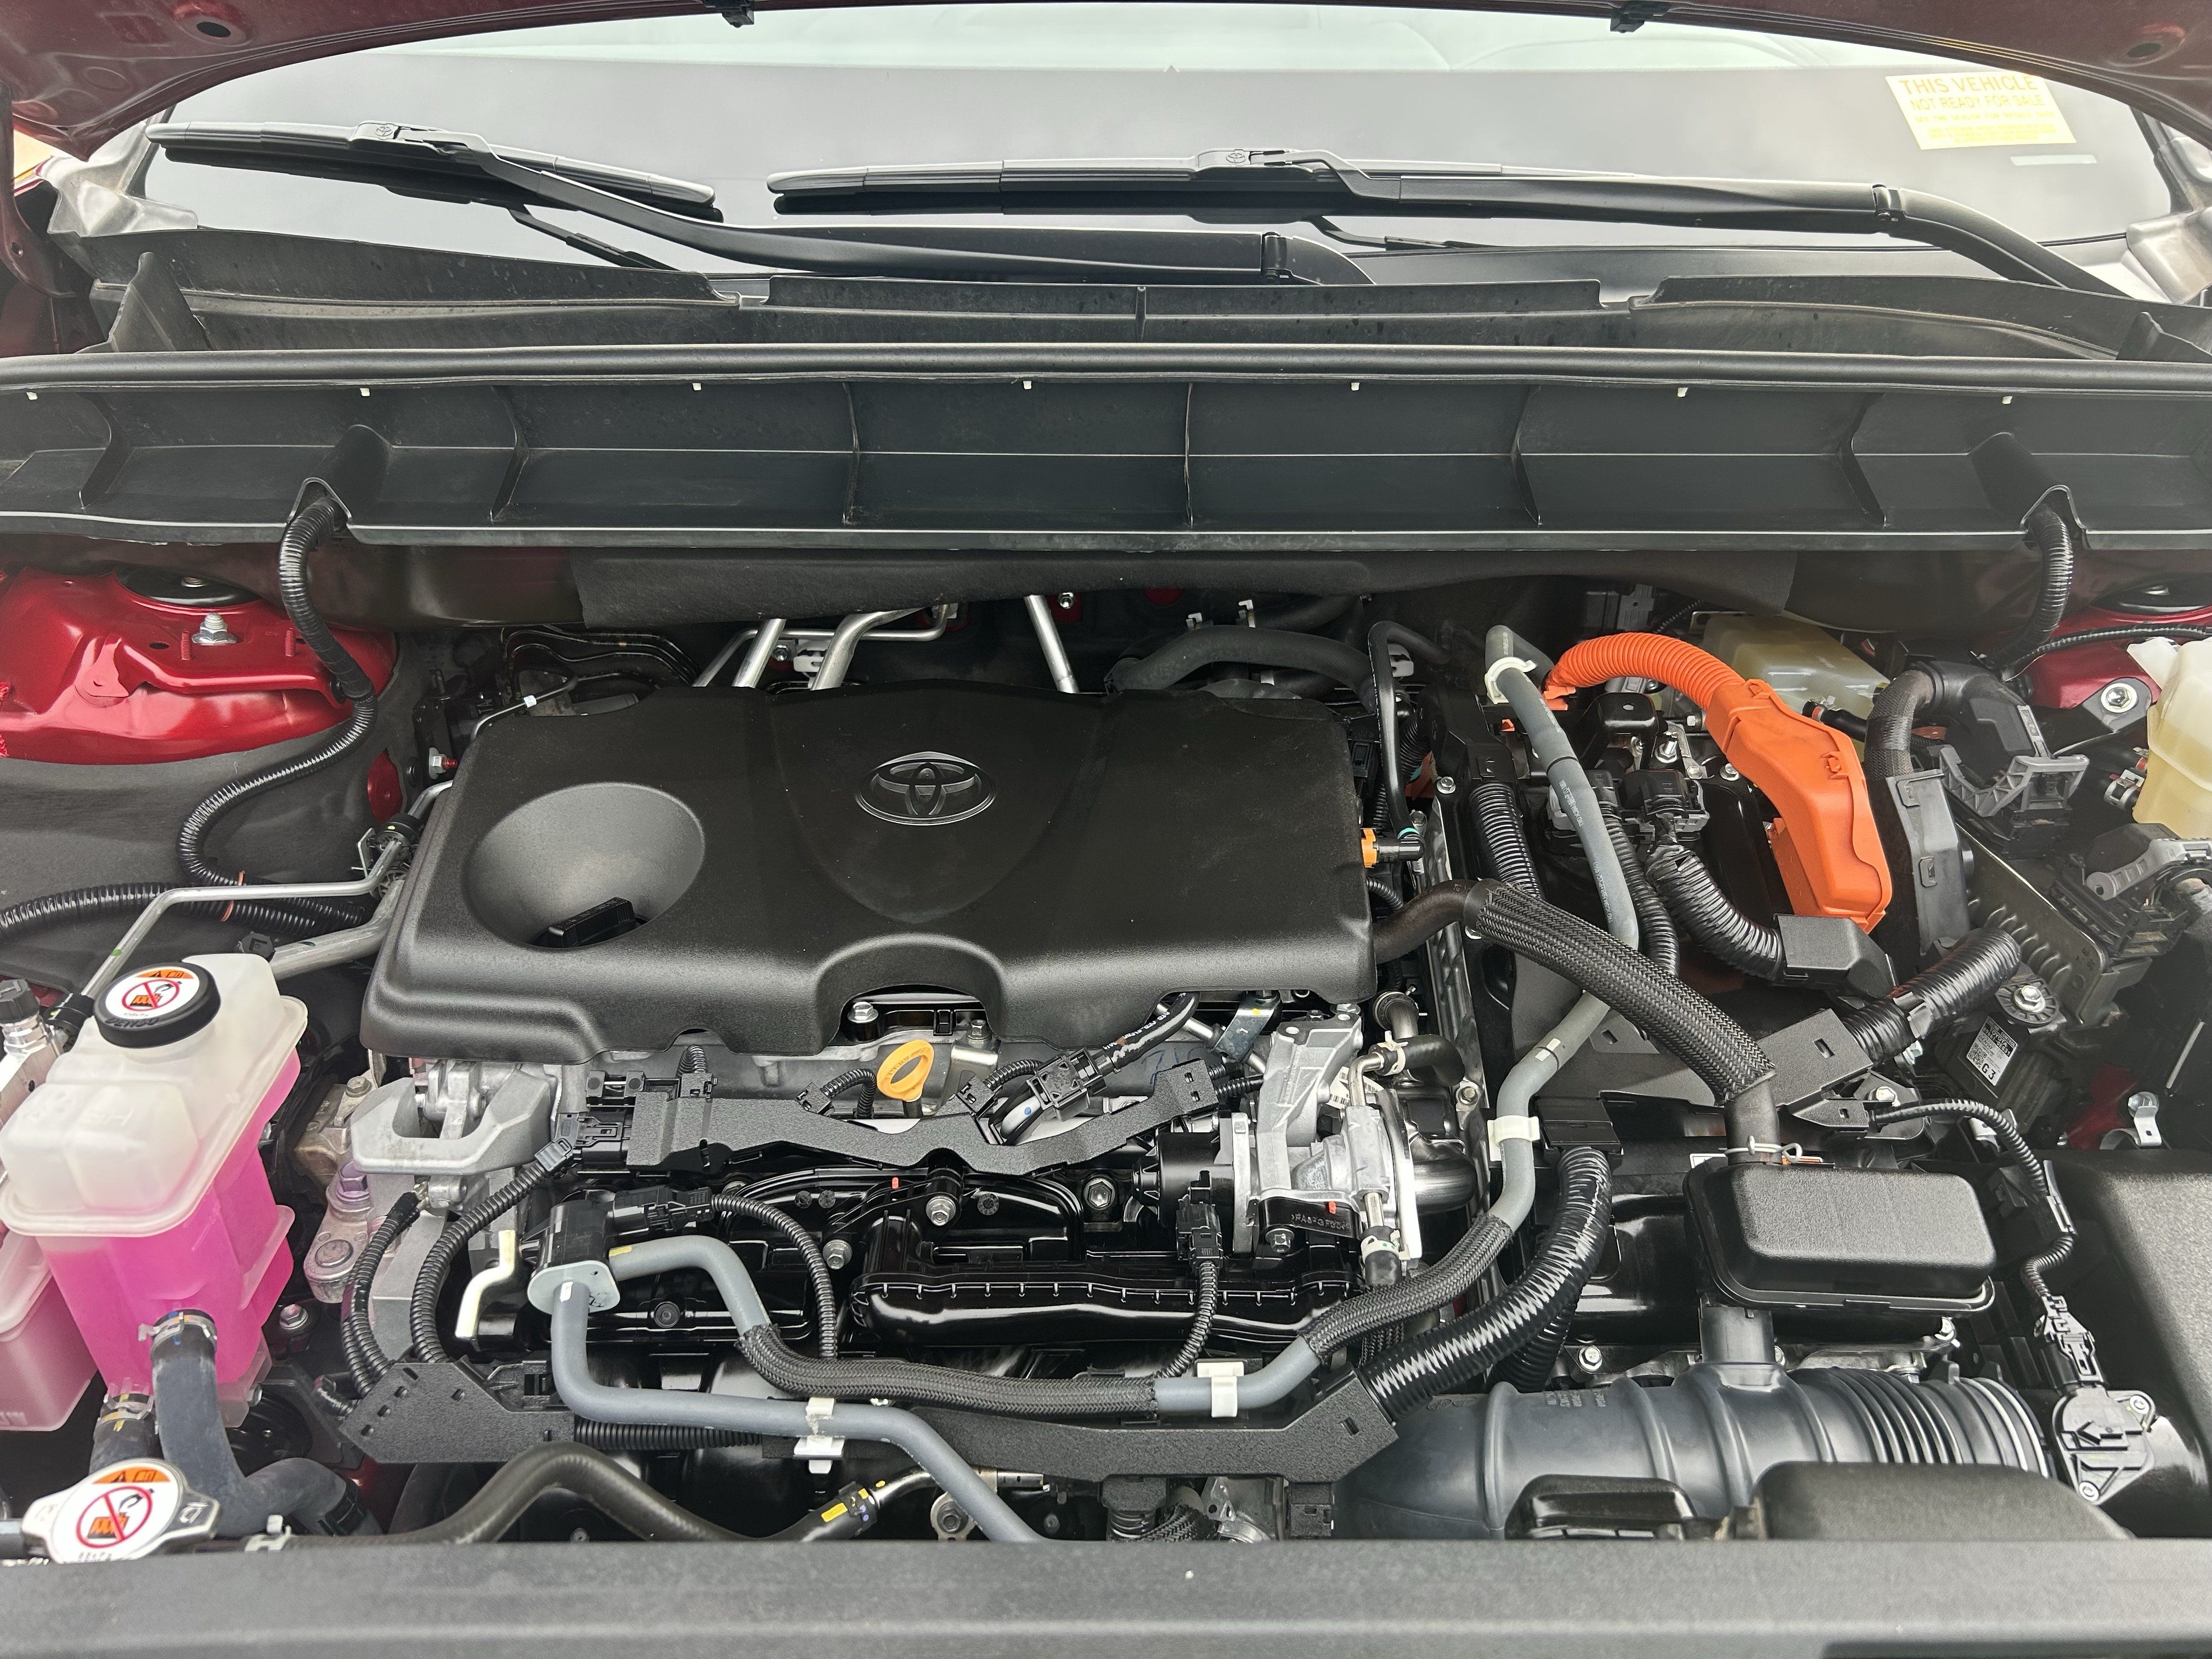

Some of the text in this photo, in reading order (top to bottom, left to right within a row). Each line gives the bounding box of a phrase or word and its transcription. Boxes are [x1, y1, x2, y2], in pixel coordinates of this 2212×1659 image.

[1899, 76, 2039, 94] THIS VEHICLE
[1910, 94, 2045, 110] NOT READY FOR SALE
[1989, 1026, 2007, 1046] TOYOTA
